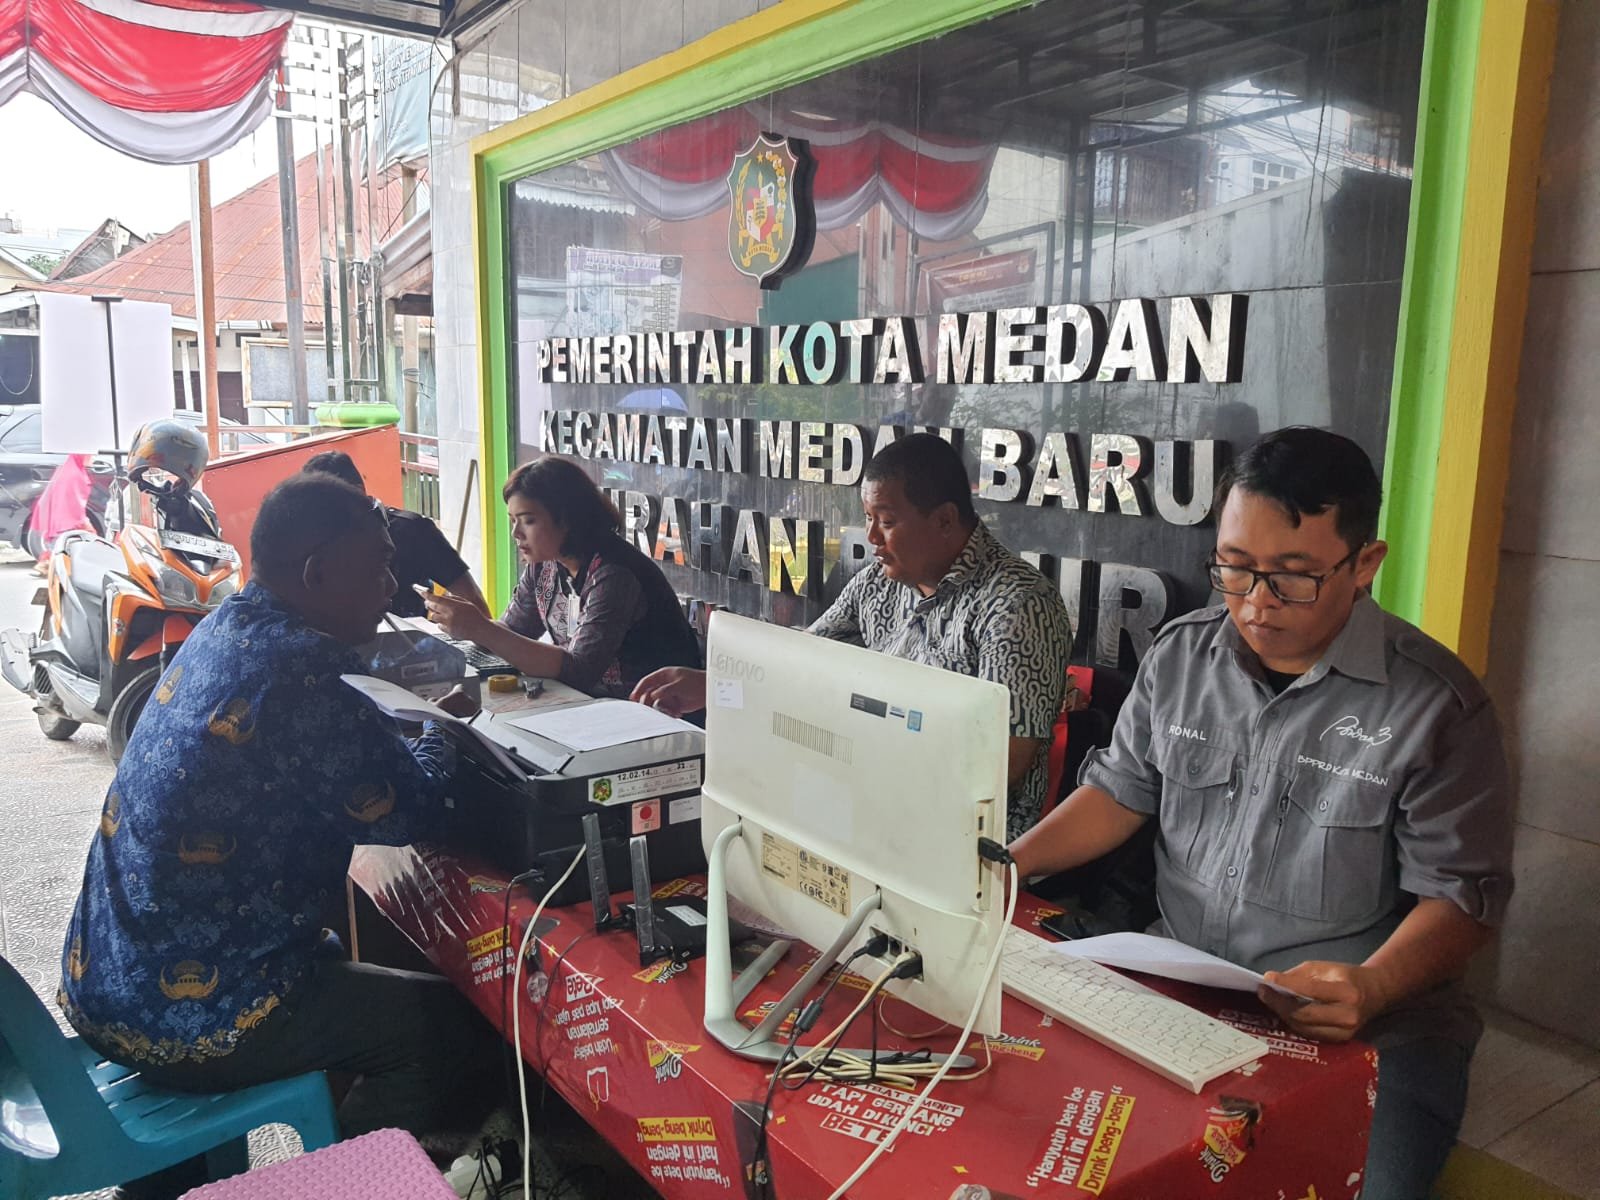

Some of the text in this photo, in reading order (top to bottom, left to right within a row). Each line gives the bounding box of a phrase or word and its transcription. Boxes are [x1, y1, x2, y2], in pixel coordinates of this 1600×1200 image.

[536, 293, 1235, 385] PEMERINTAH KOTA MEDAN
[539, 410, 1215, 526] KECAMATAN MED BARU
[1168, 724, 1208, 741] RONAL
[655, 960, 688, 984] Drink
[987, 1031, 1041, 1047] Drink
[654, 1053, 683, 1085] Drink
[807, 1093, 857, 1115] UDAH
[821, 1082, 867, 1103] TAPI
[1064, 1087, 1084, 1102] loe
[1056, 1103, 1078, 1127] bete
[687, 1118, 714, 1138] Drink
[1052, 1090, 1104, 1184] hari ini dengan
[646, 1144, 719, 1166] hari ini dengan
[1198, 1145, 1230, 1183] Drink
[663, 1165, 683, 1182] bete
[1084, 1157, 1108, 1190] Drink
